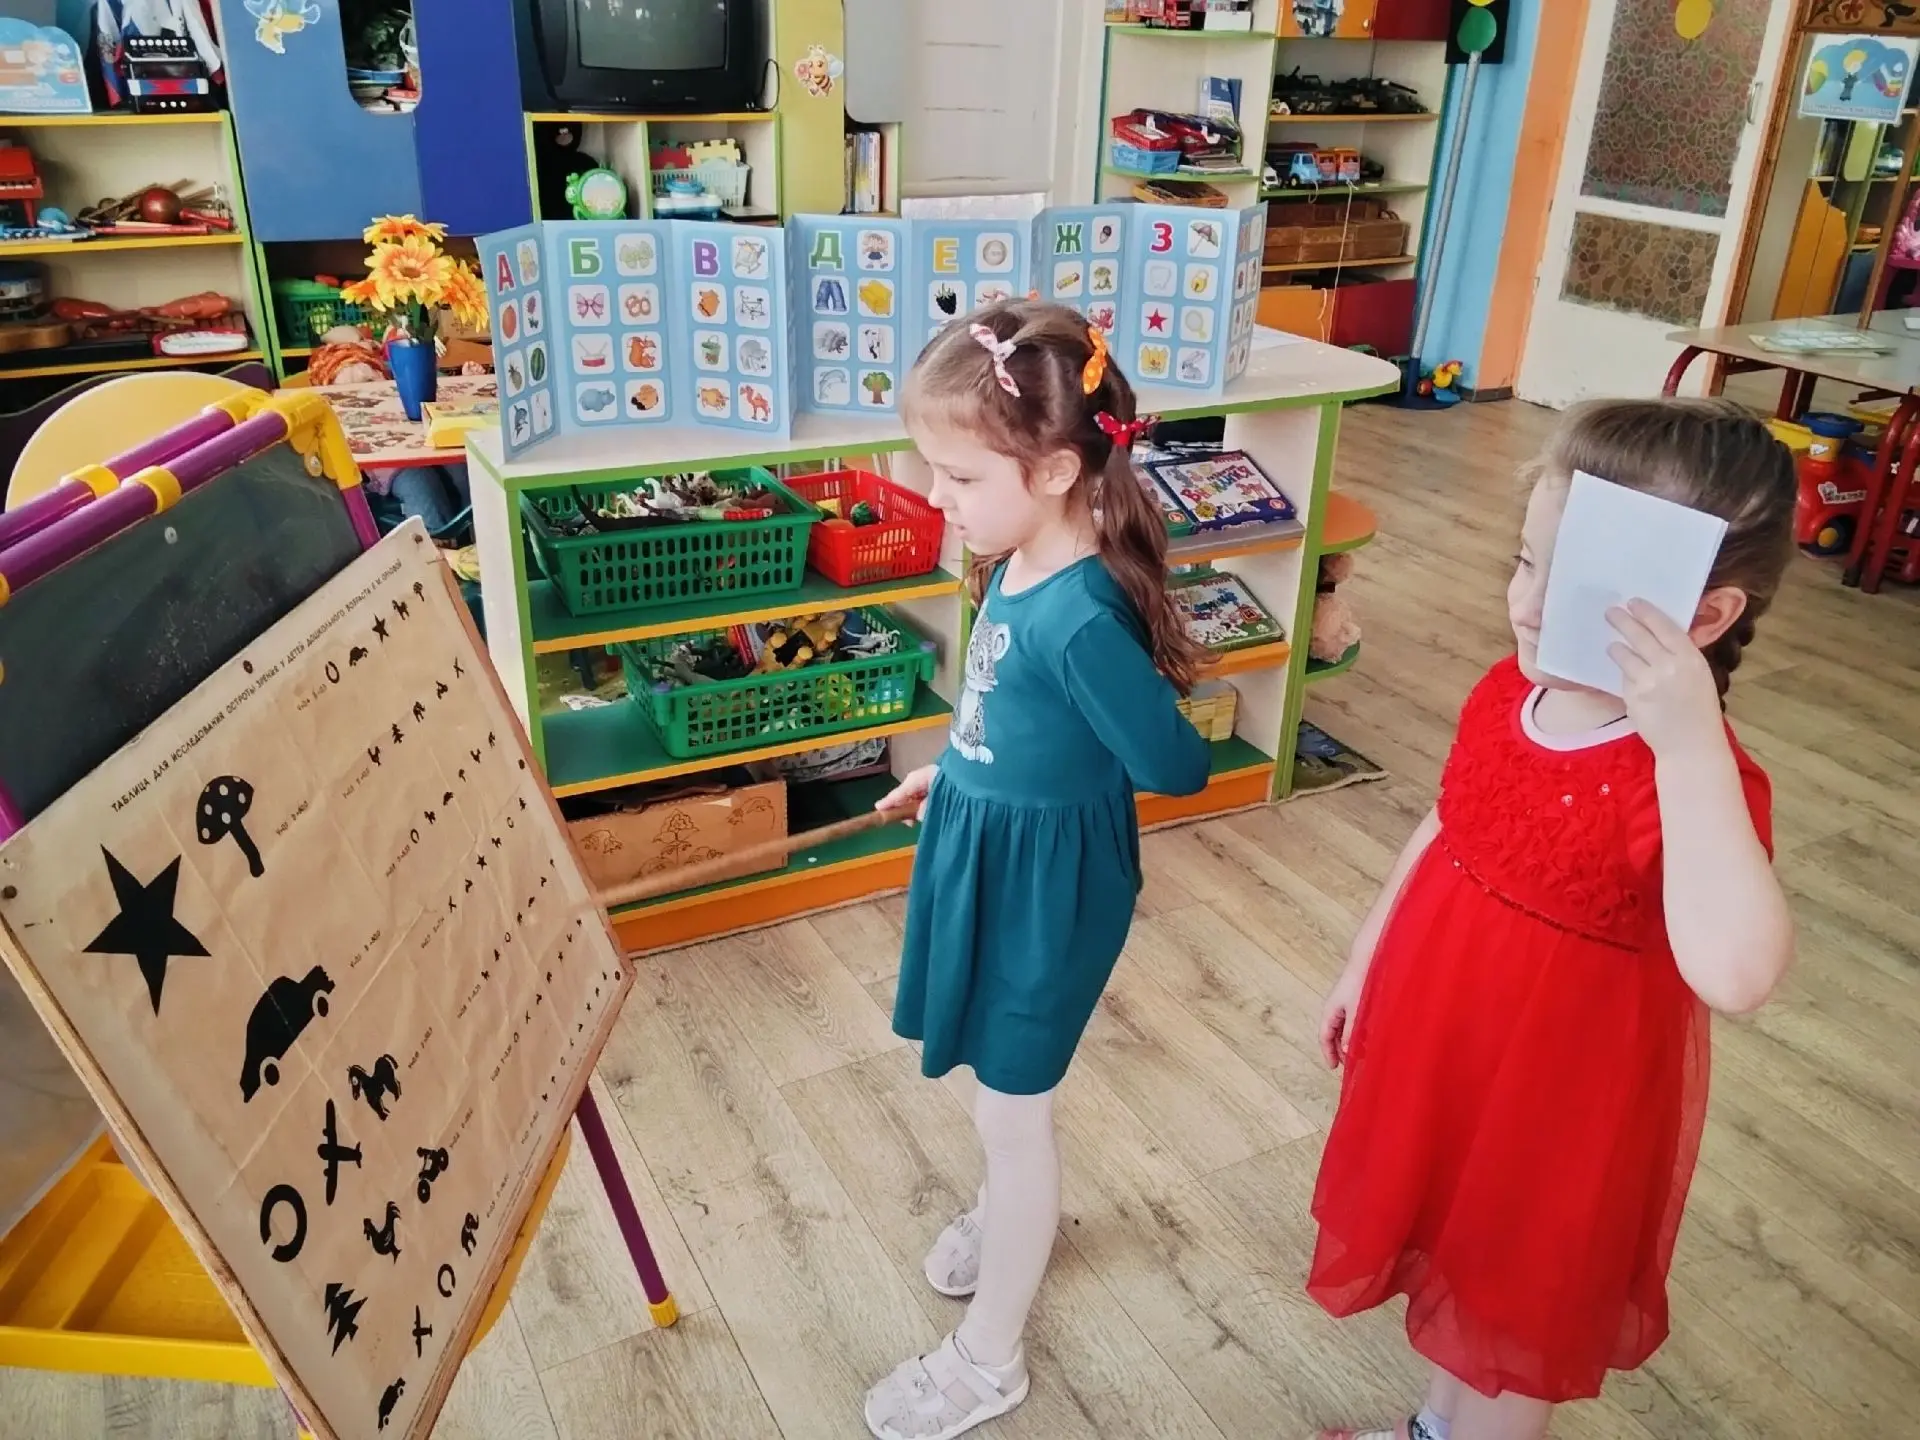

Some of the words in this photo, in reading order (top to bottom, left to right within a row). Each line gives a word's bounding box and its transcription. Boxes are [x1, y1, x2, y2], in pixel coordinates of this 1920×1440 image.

[809, 231, 843, 270] Д
[933, 238, 959, 273] Е
[1055, 223, 1082, 254] Ж
[497, 253, 515, 294] А
[569, 239, 601, 276] Б
[693, 240, 720, 276] В
[111, 778, 150, 812] ТАБЛИЦА
[153, 760, 169, 781] ДЛЯ
[171, 712, 225, 762] ИССЛЕДОВАНИЯ
[225, 687, 256, 714] ОСТРОТЫ
[256, 665, 280, 689] ЗРЕНИЯ
[287, 642, 305, 664] ДЕТЕЙ
